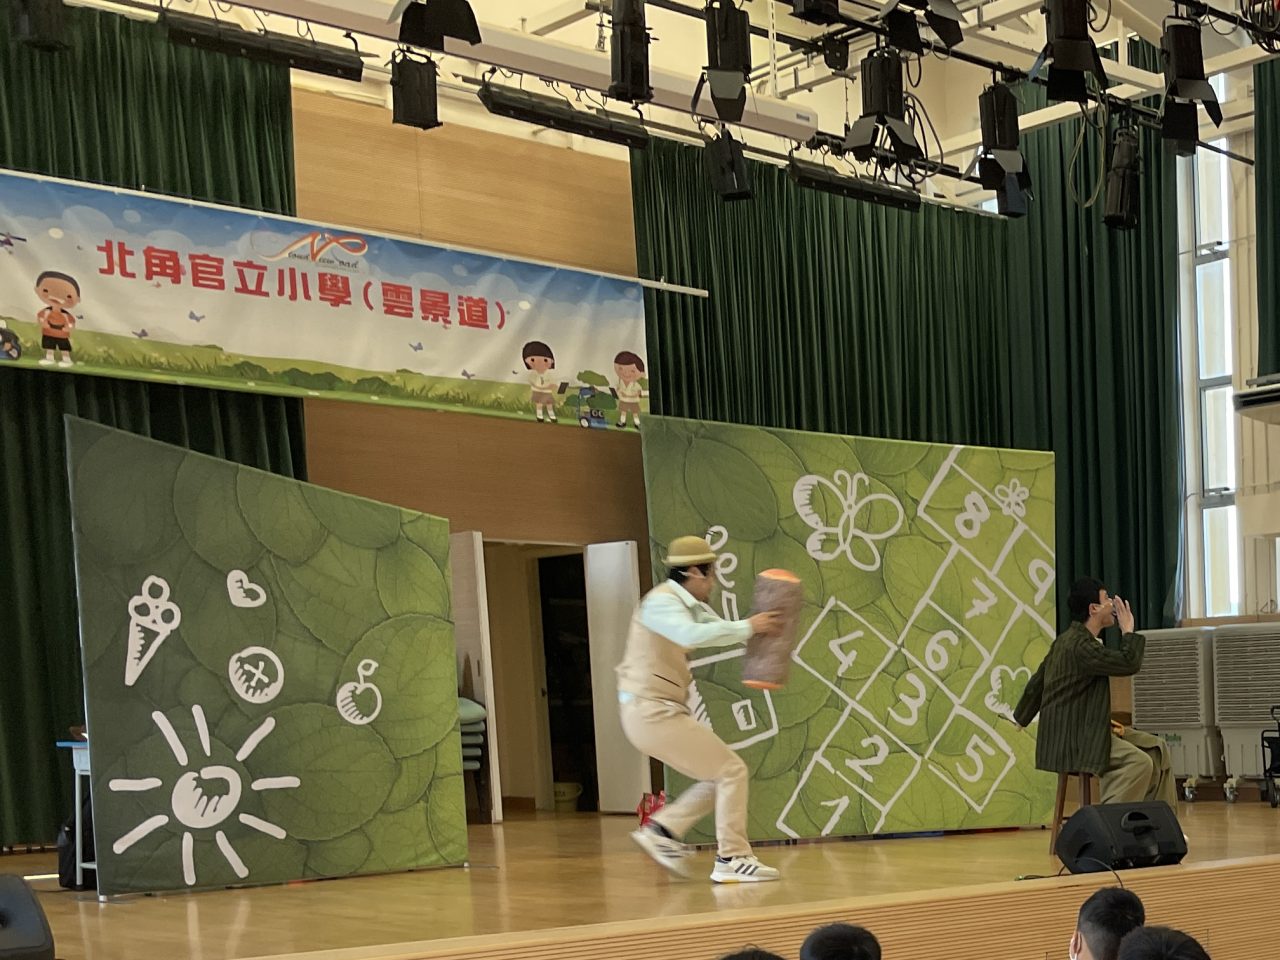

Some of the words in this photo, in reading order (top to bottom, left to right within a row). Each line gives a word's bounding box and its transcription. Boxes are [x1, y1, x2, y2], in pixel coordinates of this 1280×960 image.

[954, 491, 990, 538] 8
[965, 576, 998, 619] 7
[1028, 558, 1056, 605] 9
[829, 631, 864, 676] 4
[925, 630, 960, 671] 6
[887, 673, 926, 726] 3
[845, 735, 889, 783] 2
[956, 734, 996, 782] 5
[820, 795, 850, 837] 1
